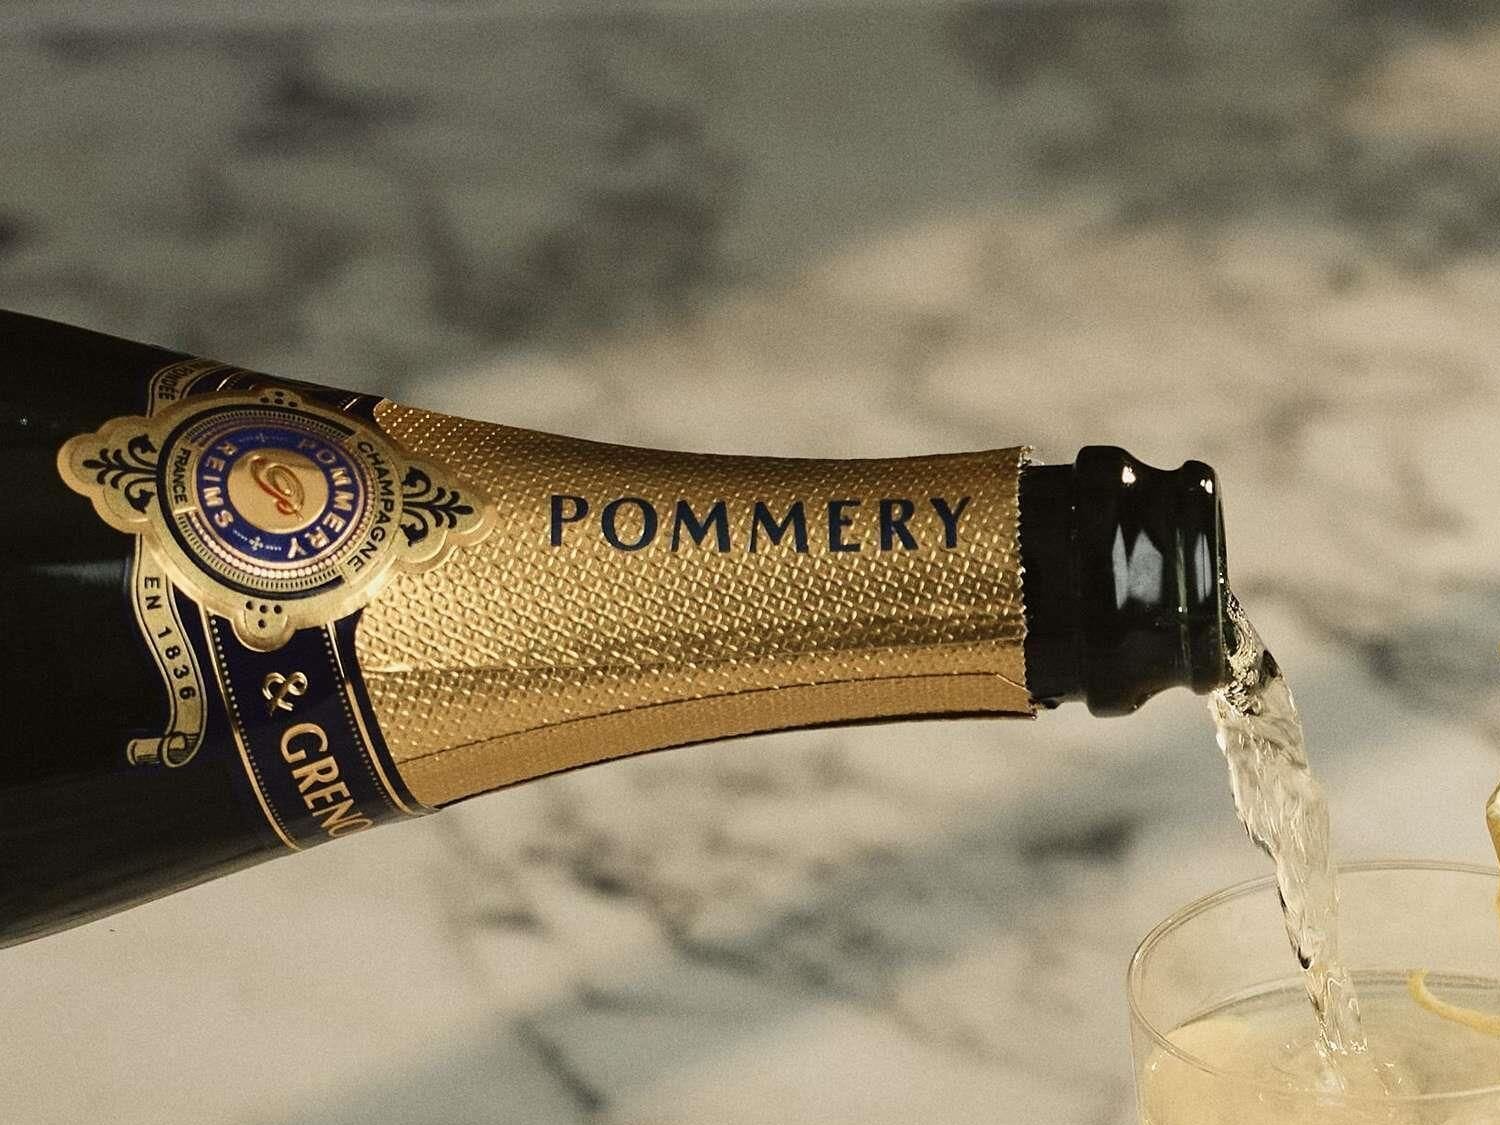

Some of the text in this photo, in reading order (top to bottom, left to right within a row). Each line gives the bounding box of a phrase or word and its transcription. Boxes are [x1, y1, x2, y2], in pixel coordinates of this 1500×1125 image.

[172, 447, 192, 504] FRANCE
[202, 442, 239, 528] REIMS
[287, 438, 355, 559] POMMERY
[347, 441, 395, 572] CHAMPAGNE
[549, 495, 972, 553] POMMERY
[144, 576, 196, 700] EN 1836
[262, 671, 308, 716] &
